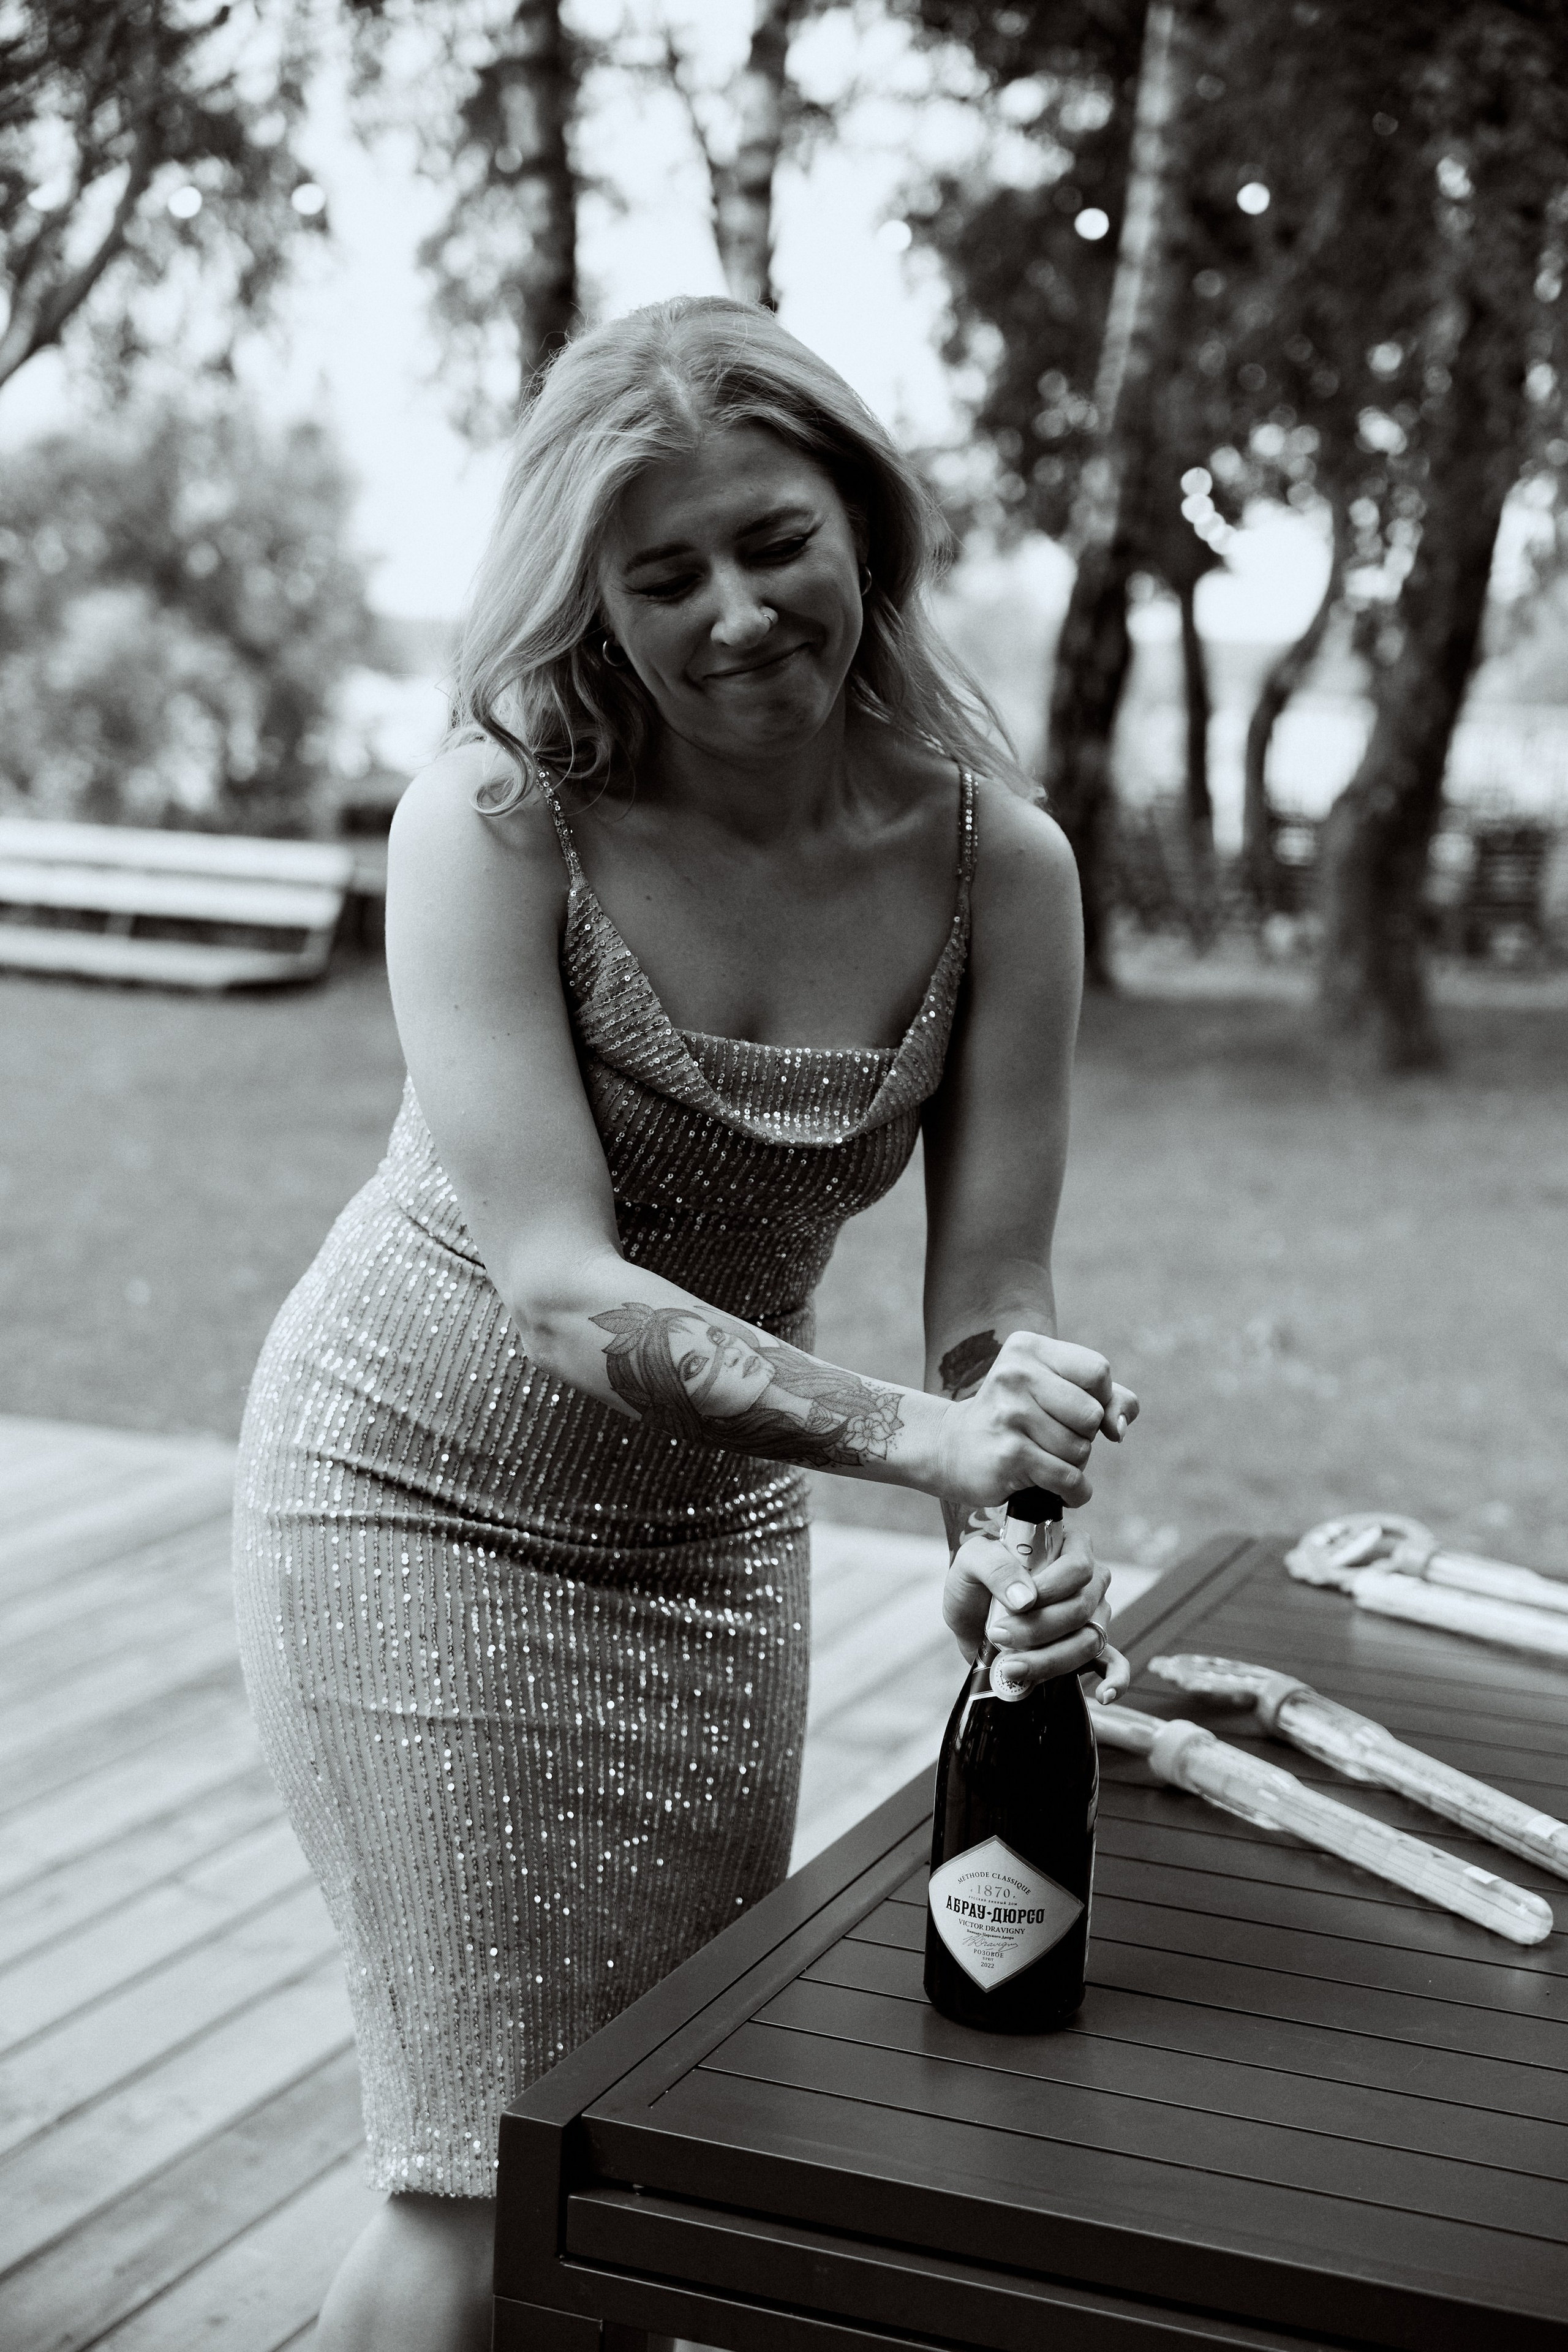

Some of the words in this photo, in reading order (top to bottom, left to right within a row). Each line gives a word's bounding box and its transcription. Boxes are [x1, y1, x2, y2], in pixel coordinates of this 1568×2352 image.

[992, 1872, 1031, 1895] CLASSIQUE
[977, 1885, 1011, 1898] 1870
[959, 1918, 984, 1930] VICTOR
[986, 1925, 1026, 1935] DRAVIGNY
[974, 1948, 1004, 1958] РОЗОВОЕ
